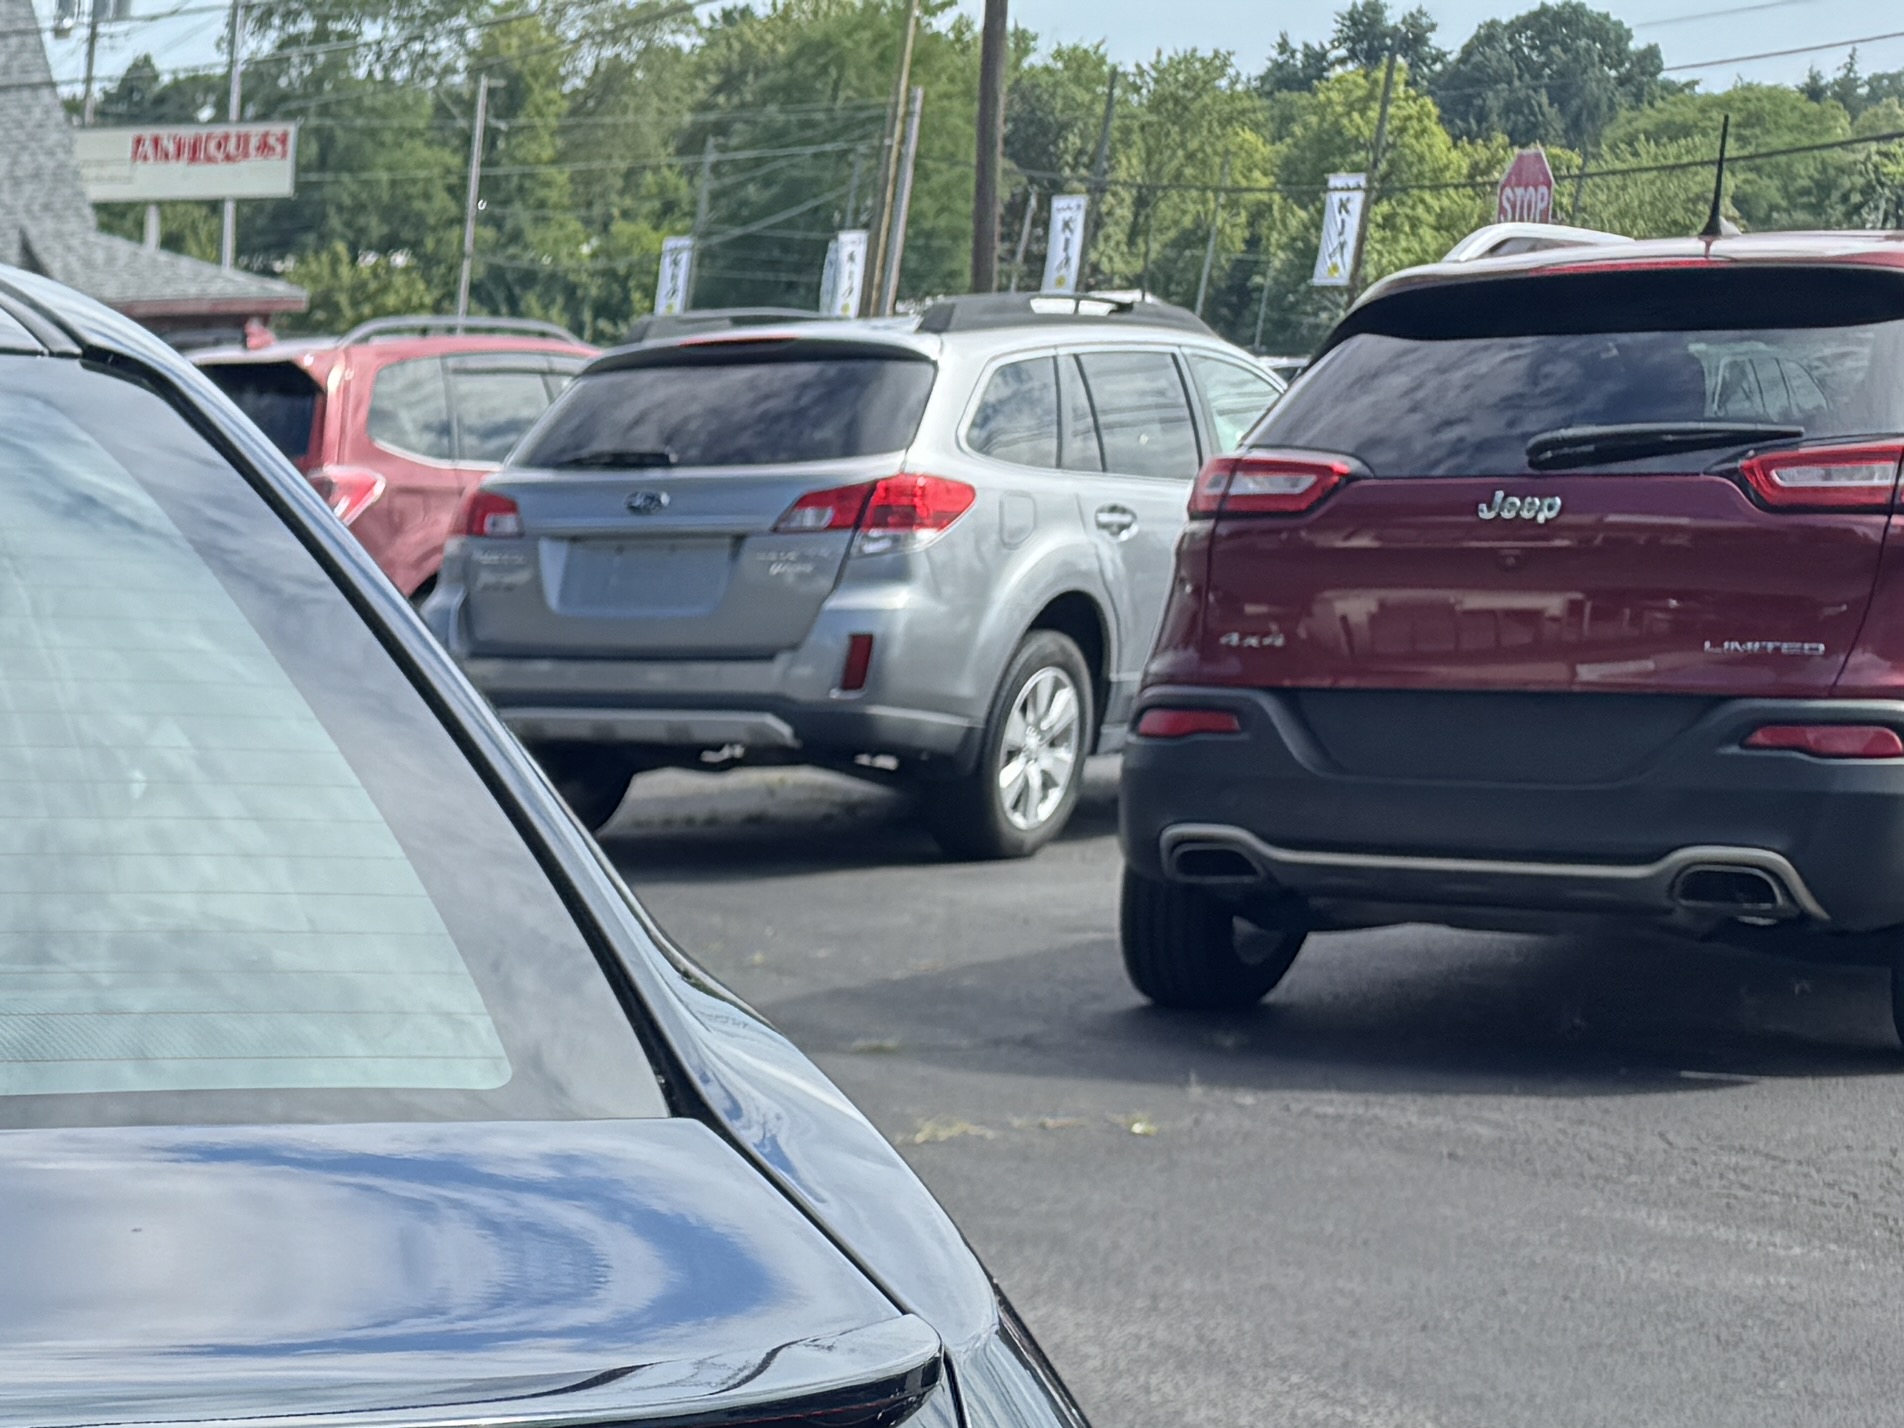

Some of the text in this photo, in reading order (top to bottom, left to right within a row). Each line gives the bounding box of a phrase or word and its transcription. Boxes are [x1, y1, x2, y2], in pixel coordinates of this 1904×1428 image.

[1500, 185, 1549, 223] STOP
[1477, 490, 1562, 524] Jeep
[1703, 640, 1826, 655] LIMITED
